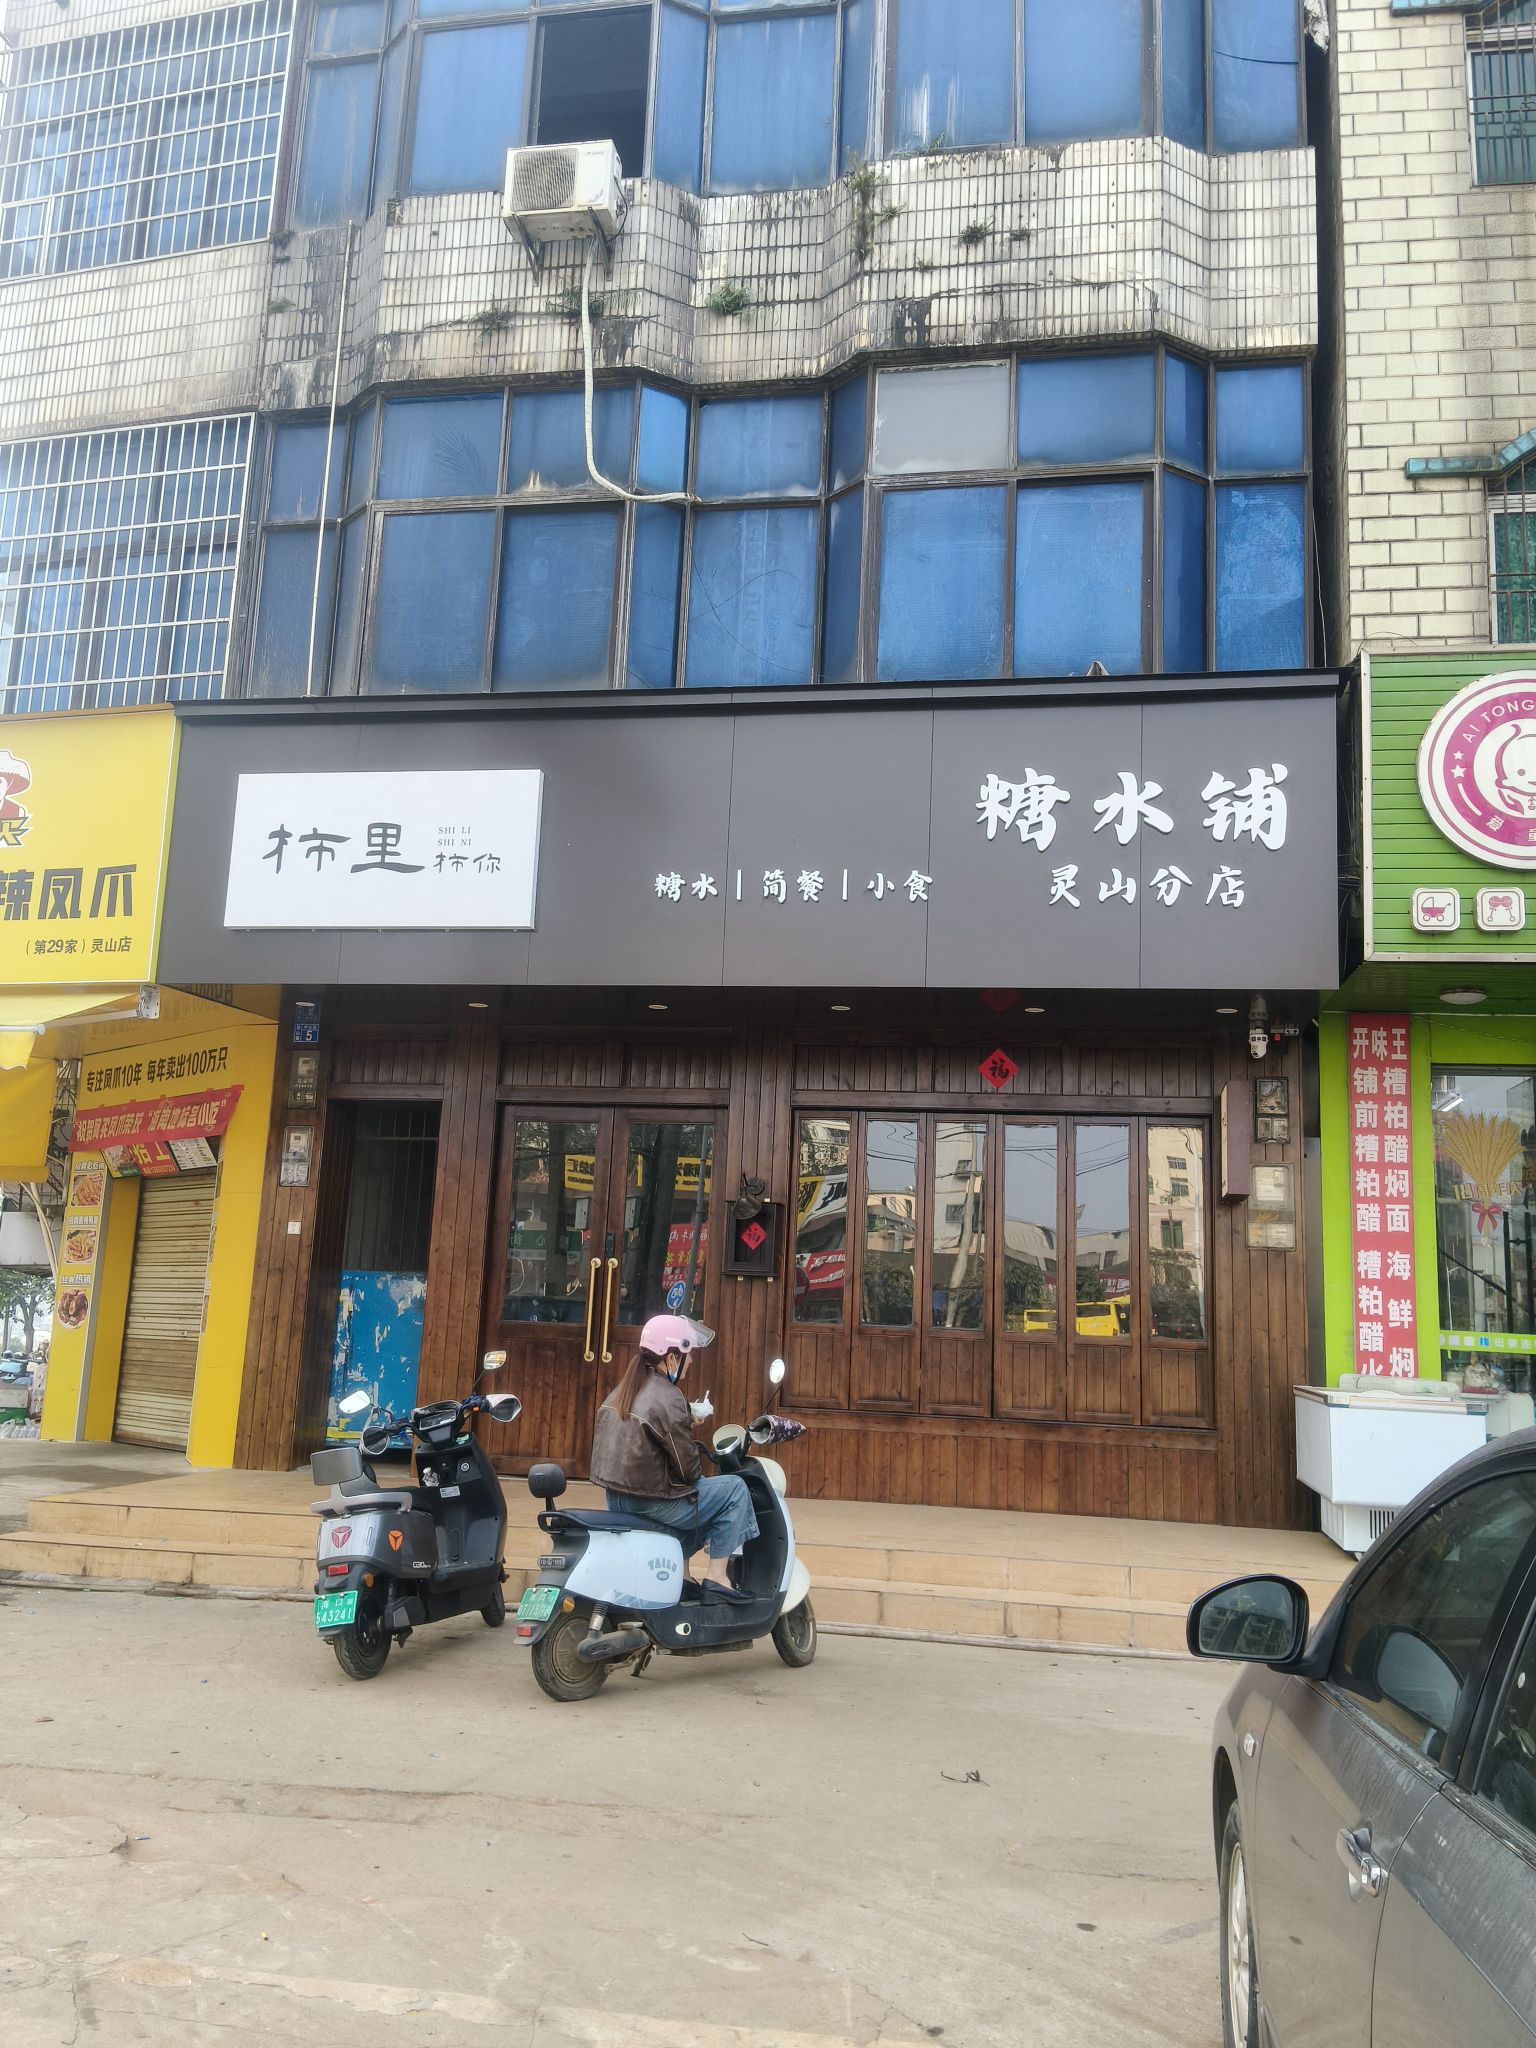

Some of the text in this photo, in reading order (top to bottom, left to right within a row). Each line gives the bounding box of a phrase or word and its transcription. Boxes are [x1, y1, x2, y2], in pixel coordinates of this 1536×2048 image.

[1462, 699, 1535, 744] AI TONG
[975, 762, 1288, 852] 糖水铺
[262, 822, 426, 875] 柿里
[437, 838, 472, 847] SHI NI
[438, 826, 472, 835] SHI LI
[433, 852, 502, 874] 柿你
[654, 868, 934, 904] 糖水 简餐 小食
[1048, 863, 1246, 909] 灵山分店
[305, 1030, 313, 1041] 5
[1352, 1026, 1408, 1061] 开味王
[86, 1046, 229, 1093] 专注凤爪10年 每年卖出100万只
[1353, 1066, 1382, 1233] 铺前糟粕醋
[316, 1607, 352, 1625] 543241
